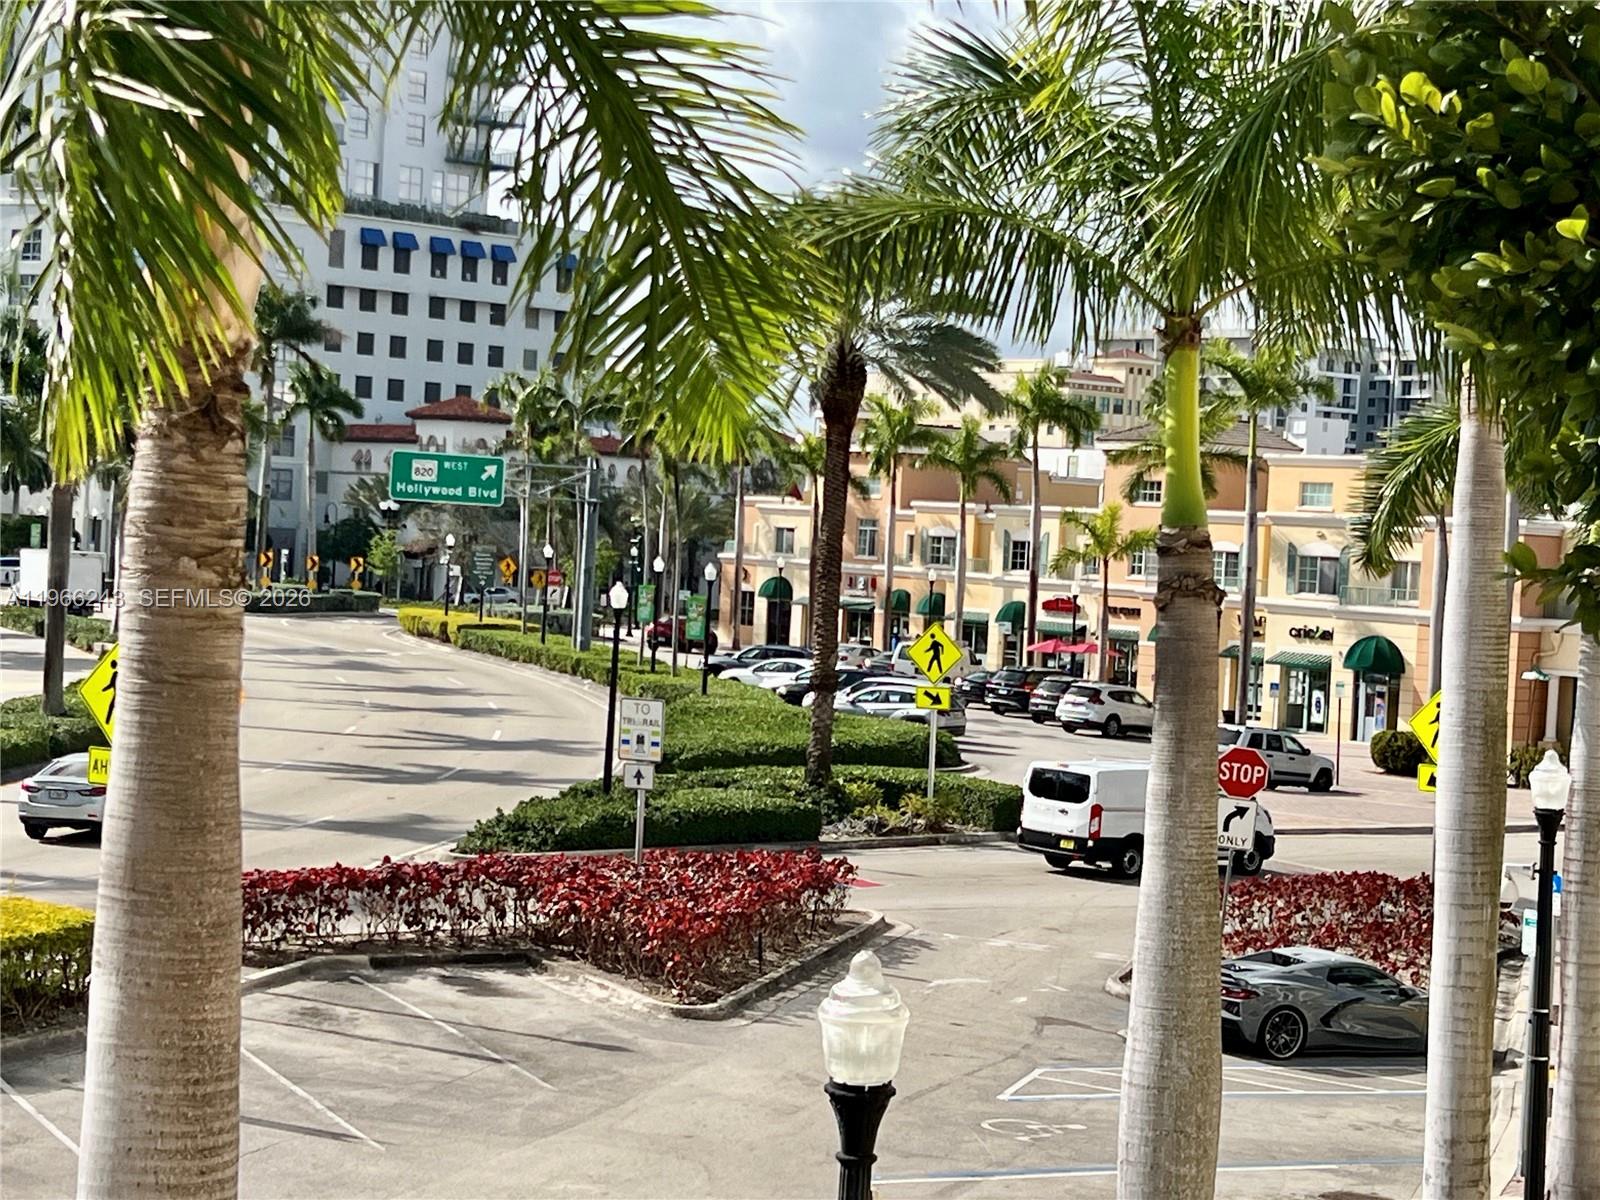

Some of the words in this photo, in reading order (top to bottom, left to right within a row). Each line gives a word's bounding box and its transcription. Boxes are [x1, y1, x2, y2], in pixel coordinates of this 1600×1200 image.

[414, 467, 434, 477] 820
[443, 461, 468, 471] WEST
[396, 482, 463, 497] Hollywood
[468, 486, 498, 499] Blvd
[633, 703, 651, 715] TO
[1219, 761, 1265, 785] STOP
[1218, 834, 1249, 847] ONLY
